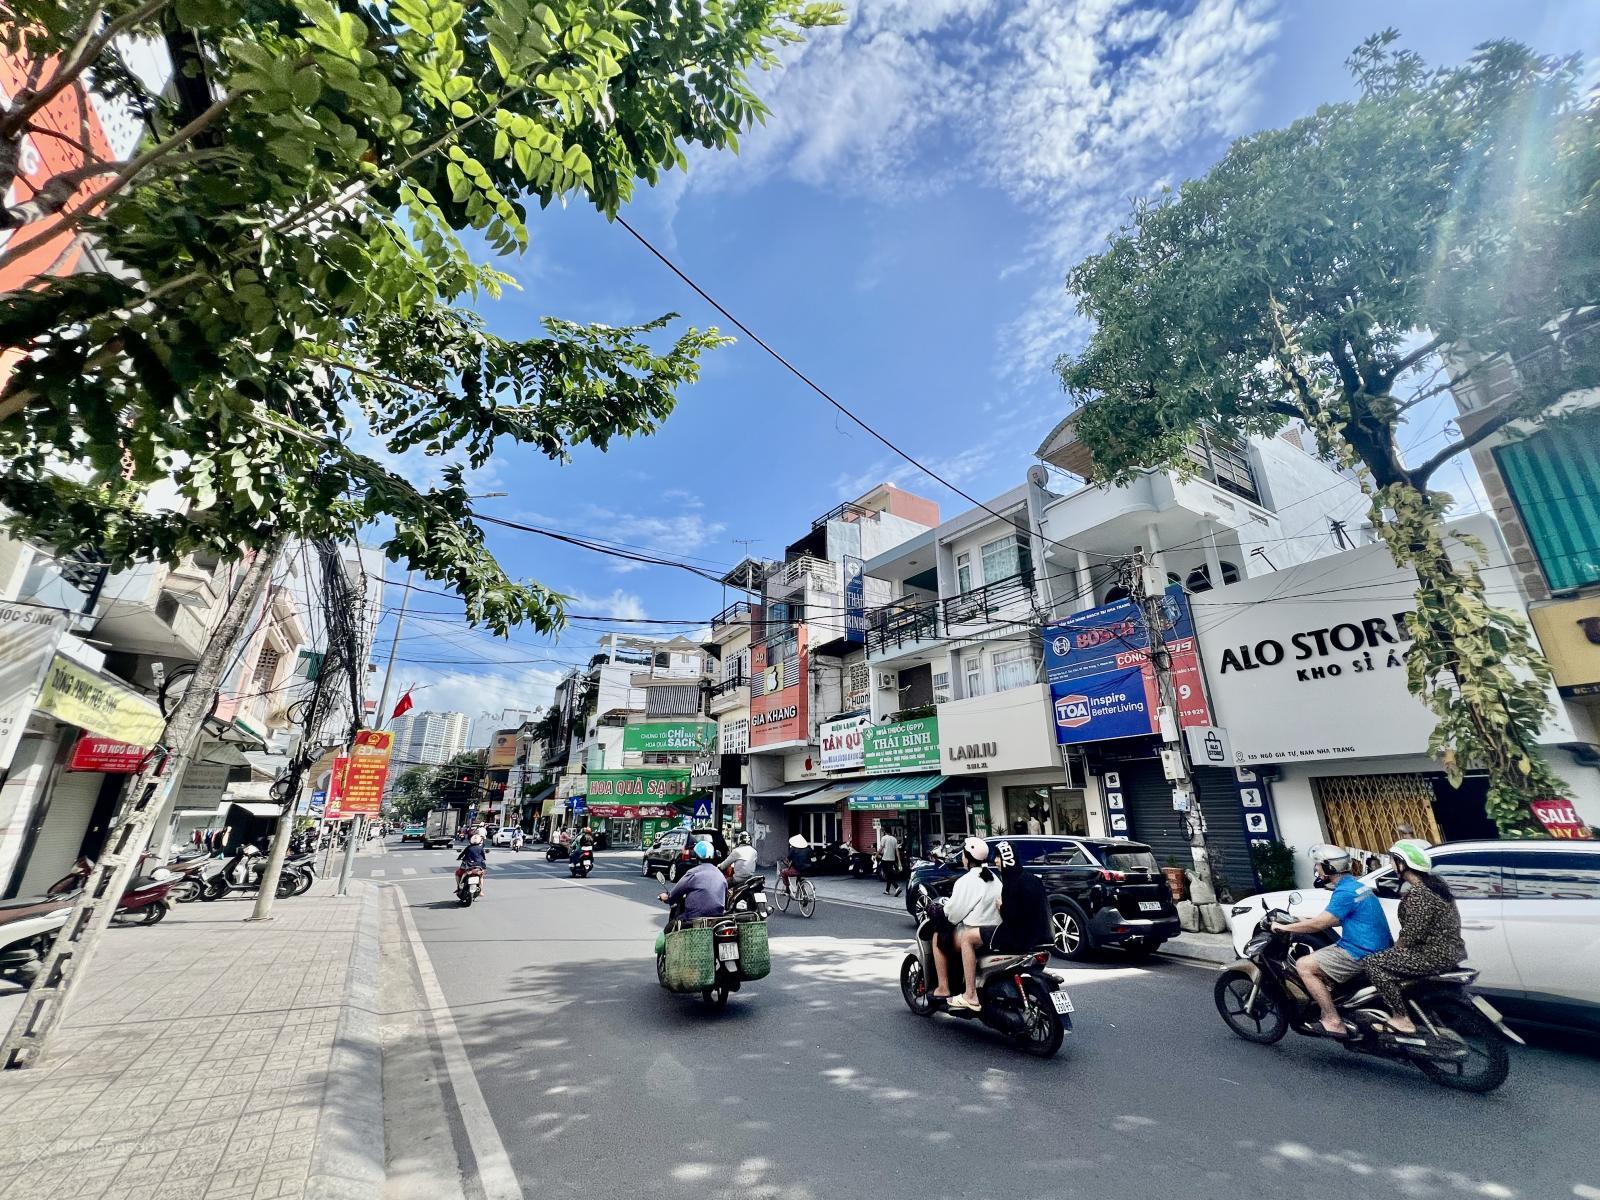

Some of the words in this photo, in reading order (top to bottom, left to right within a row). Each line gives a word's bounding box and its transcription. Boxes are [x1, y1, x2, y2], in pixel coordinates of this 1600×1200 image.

[24, 611, 54, 625] SINH
[1220, 639, 1284, 674] ALO
[1296, 664, 1342, 681] KHO
[1090, 692, 1126, 706] Inspire
[752, 714, 765, 726] GIA
[767, 705, 797, 723] KHANG
[1057, 703, 1088, 719] TOA
[1092, 706, 1117, 717] Better
[1117, 702, 1144, 713] Living
[667, 726, 684, 739] CHỈ
[907, 722, 924, 732] (GPP)
[667, 738, 695, 749] SẠCH
[823, 733, 843, 751] TÂN
[873, 735, 899, 750] THÁI
[902, 731, 931, 747] BÌNH
[92, 744, 107, 754] 170
[690, 761, 711, 778] ANDY
[590, 780, 613, 795] HOA
[616, 776, 643, 796] QUẢ
[647, 779, 686, 798] SẠCH
